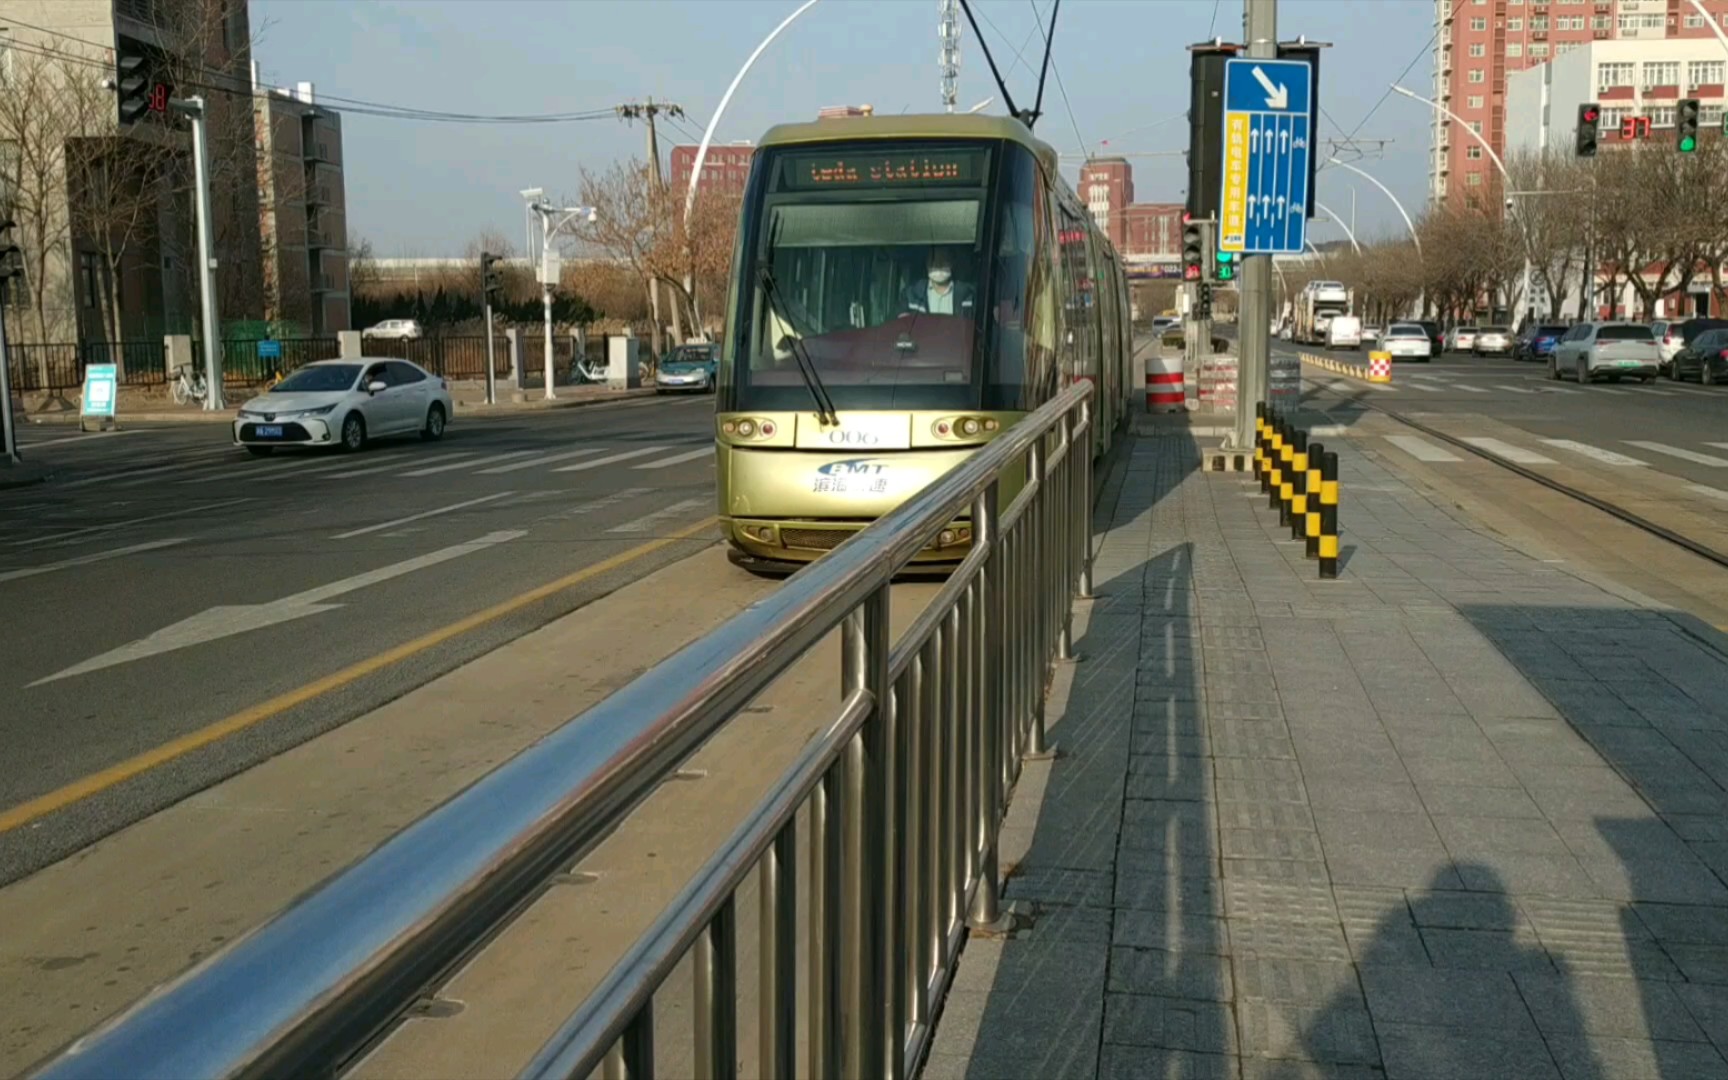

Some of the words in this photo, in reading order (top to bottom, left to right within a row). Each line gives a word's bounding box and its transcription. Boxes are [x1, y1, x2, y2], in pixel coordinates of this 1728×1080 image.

[1622, 117, 1650, 139] 37
[828, 430, 879, 444] 006
[812, 477, 888, 493] 滨海速
